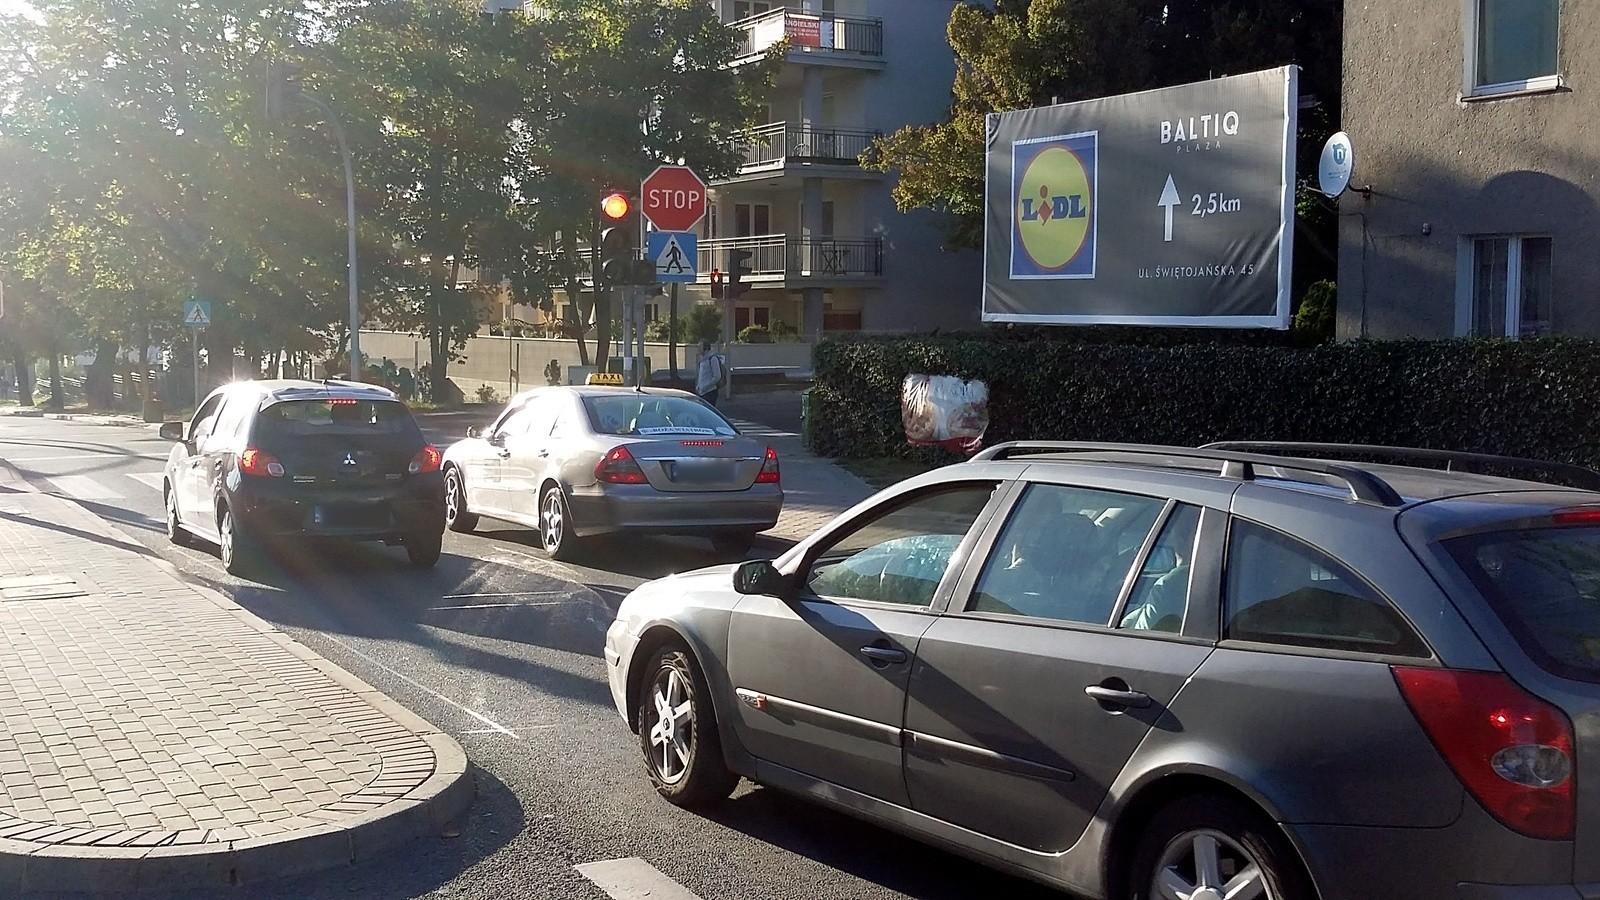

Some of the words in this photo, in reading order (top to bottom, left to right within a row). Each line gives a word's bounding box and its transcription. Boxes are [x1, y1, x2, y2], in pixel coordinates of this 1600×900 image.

[1160, 111, 1239, 144] BALTIQ
[1176, 141, 1221, 153] PLAZA
[649, 189, 700, 210] STOP
[1138, 268, 1153, 278] UL.
[1155, 263, 1235, 279] ŚWIĘTOJAŃSKA
[1240, 264, 1254, 275] 45
